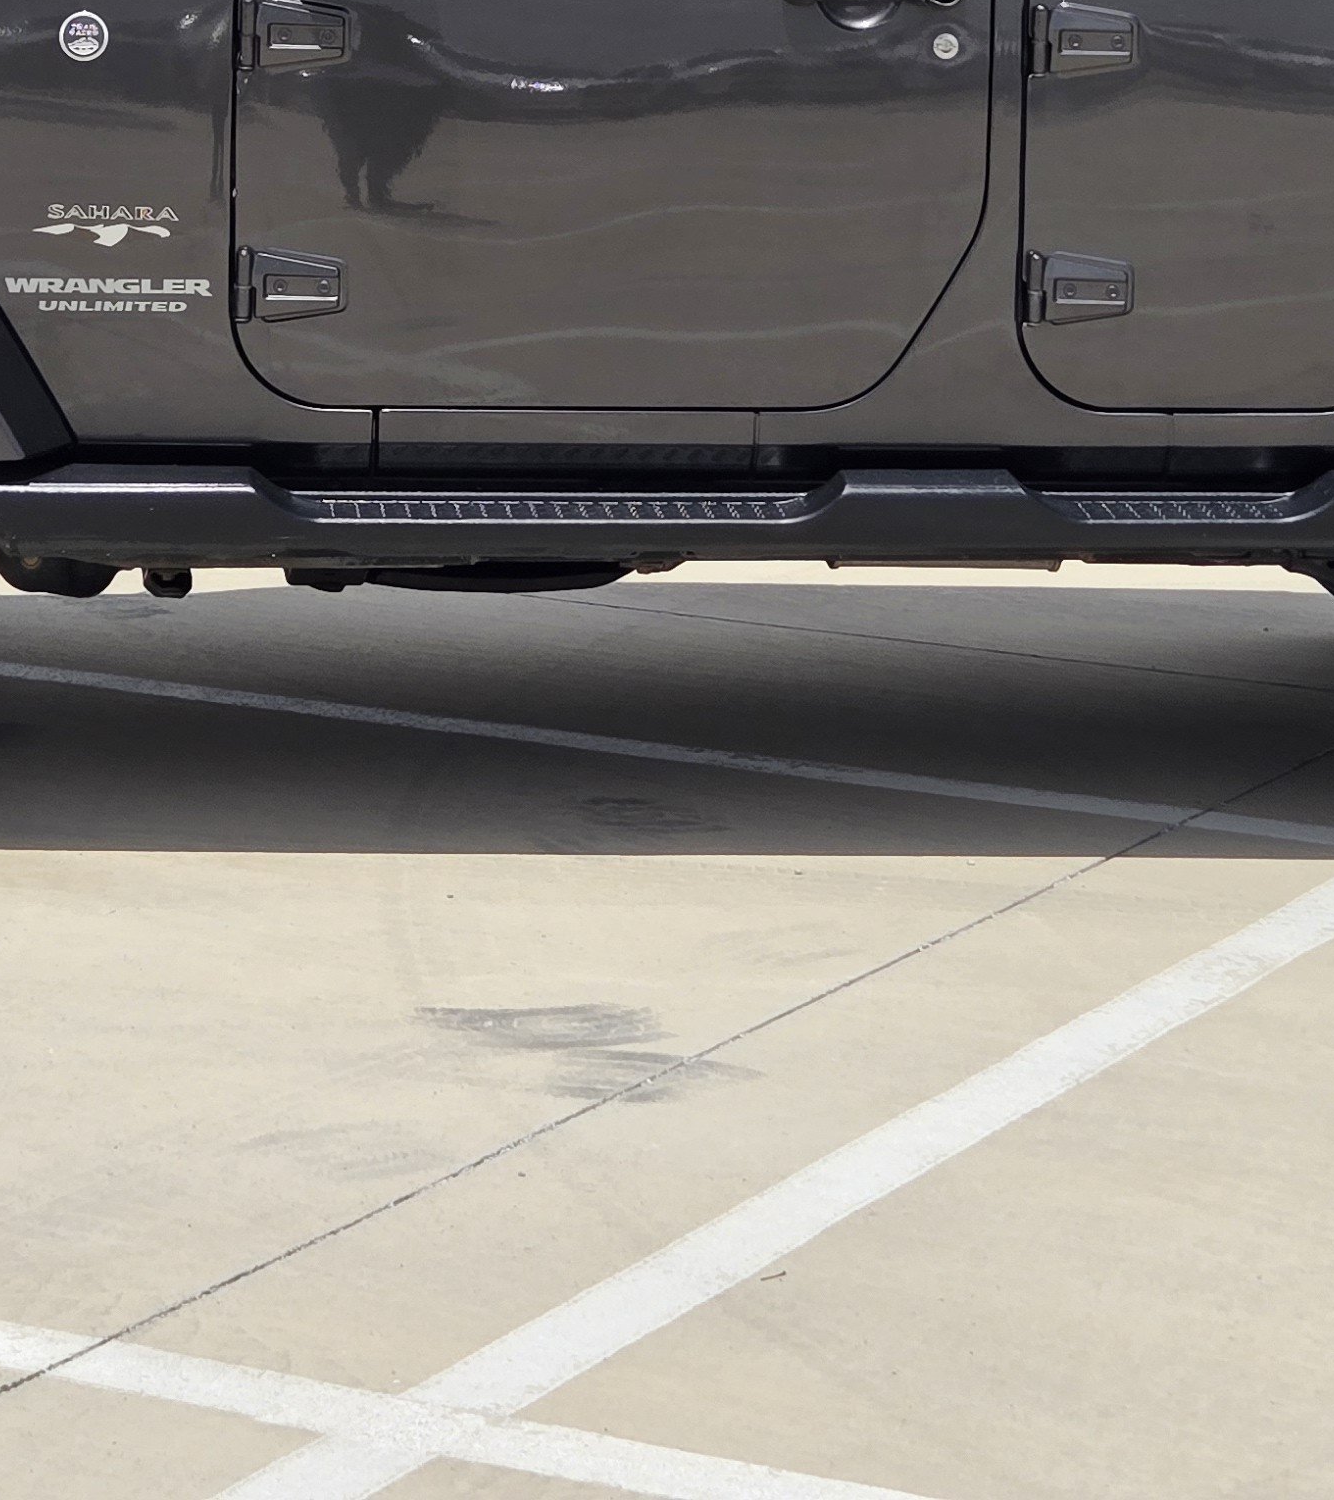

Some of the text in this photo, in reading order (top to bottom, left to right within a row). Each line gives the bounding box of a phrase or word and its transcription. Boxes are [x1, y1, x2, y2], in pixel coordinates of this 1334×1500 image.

[47, 203, 180, 221] SAHARA
[4, 277, 212, 296] WRANGLER
[38, 300, 188, 312] UNLIMITED
